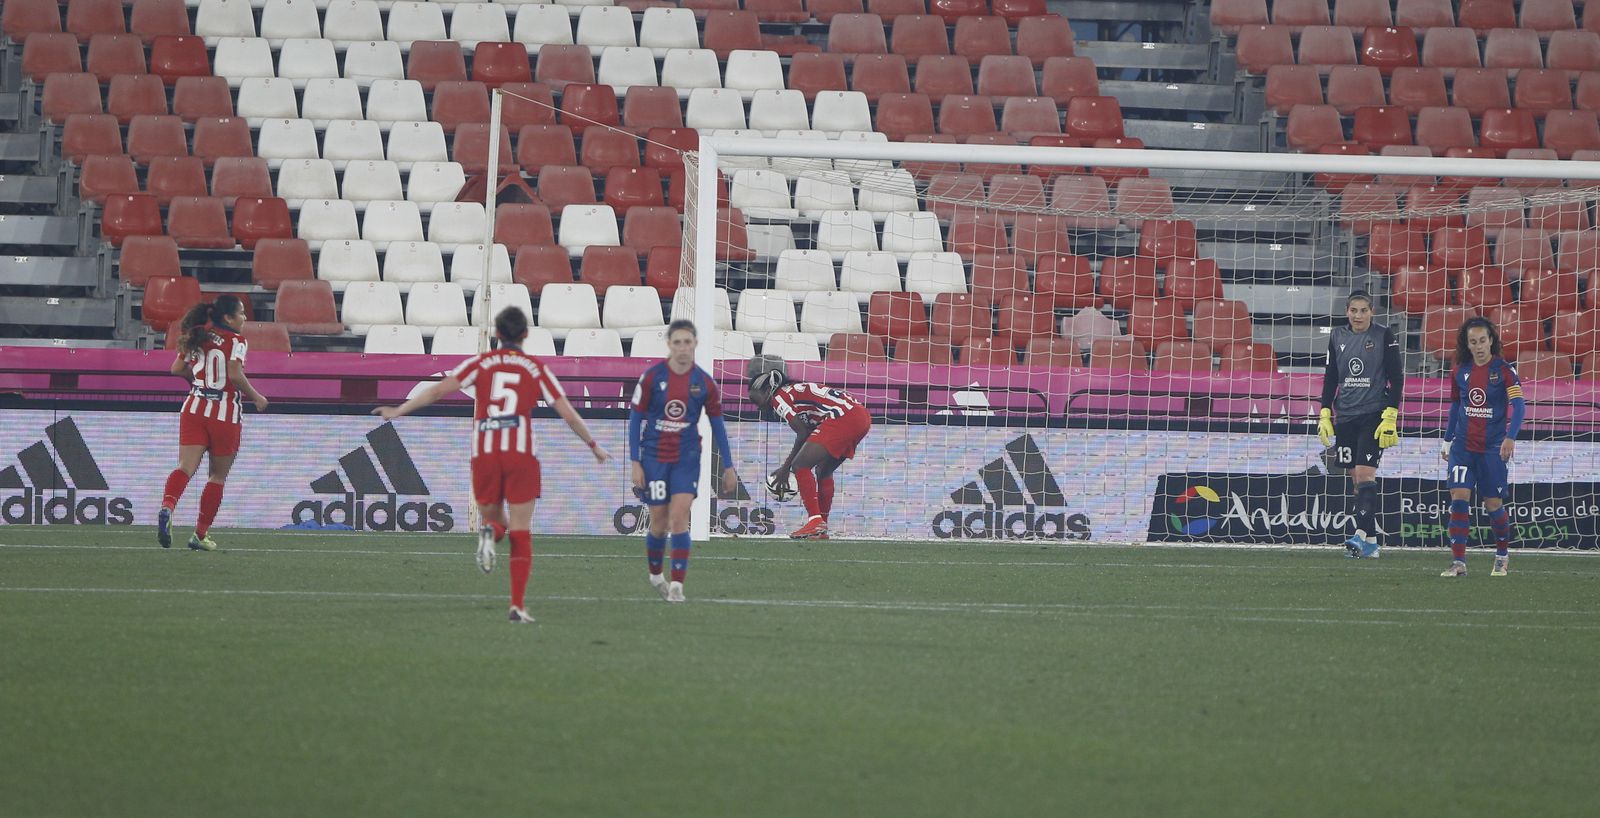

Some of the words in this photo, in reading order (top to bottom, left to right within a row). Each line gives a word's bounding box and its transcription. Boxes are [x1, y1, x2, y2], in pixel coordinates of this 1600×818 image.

[192, 346, 227, 390] 20
[486, 371, 521, 418] 5
[1337, 446, 1352, 464] 13
[1452, 465, 1468, 483] 17
[0, 487, 134, 525] didas
[649, 480, 666, 500] 18
[292, 492, 454, 532] adidas
[932, 503, 1092, 541] adidas
[1220, 491, 1390, 537] Andalucí
[1482, 501, 1569, 522] Eropea
[1514, 525, 1569, 540] 2021
